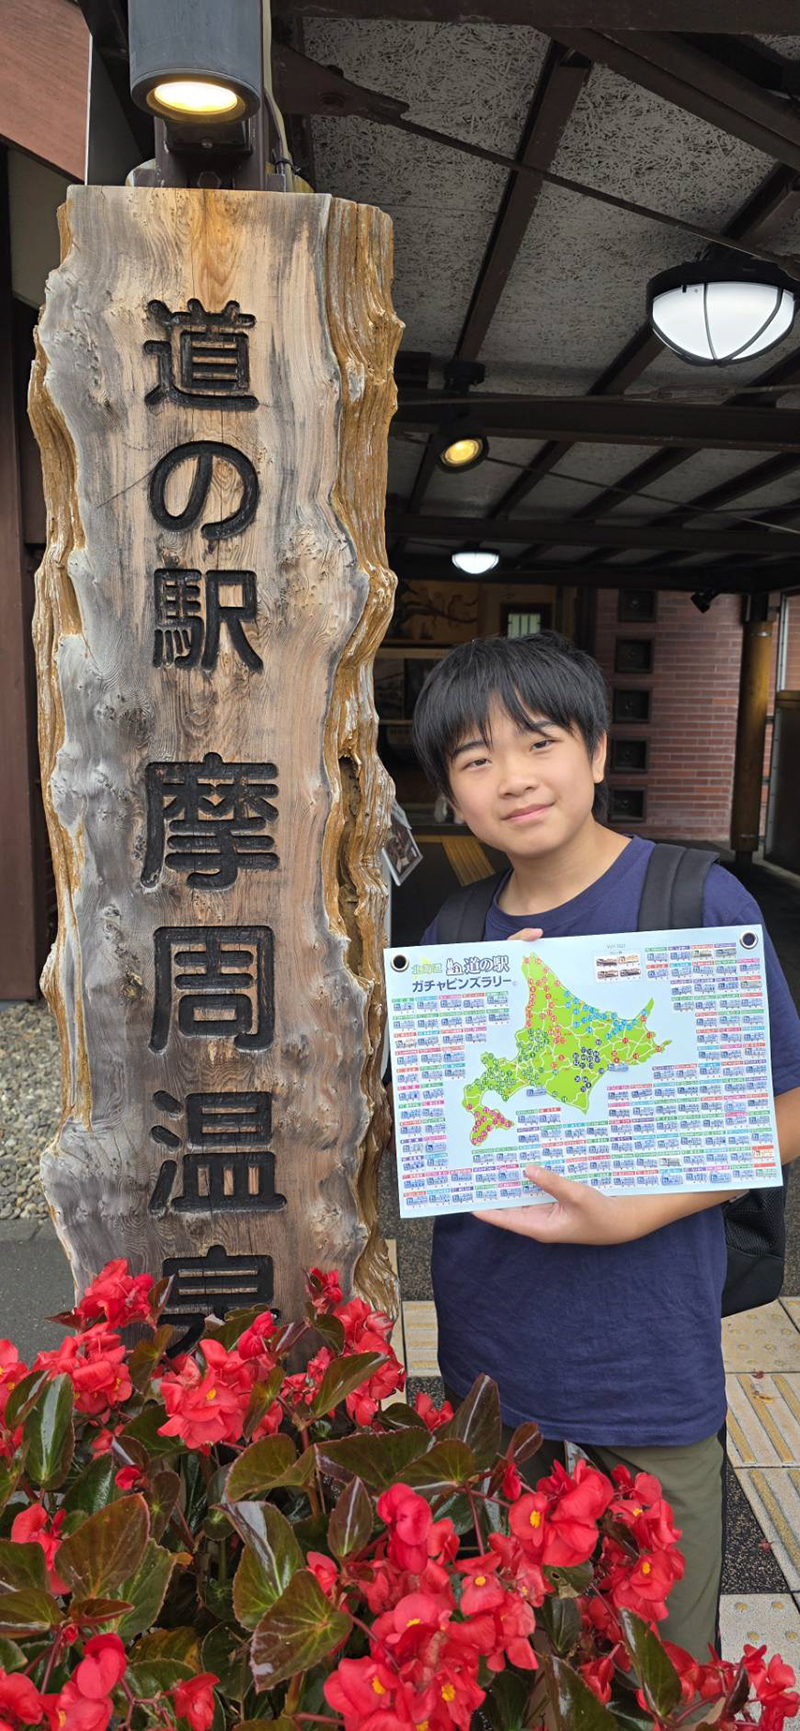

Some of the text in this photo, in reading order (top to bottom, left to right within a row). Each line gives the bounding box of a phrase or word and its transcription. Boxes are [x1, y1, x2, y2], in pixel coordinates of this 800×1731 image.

[143, 298, 262, 672] 道の駅
[464, 955, 510, 975] 道の駅
